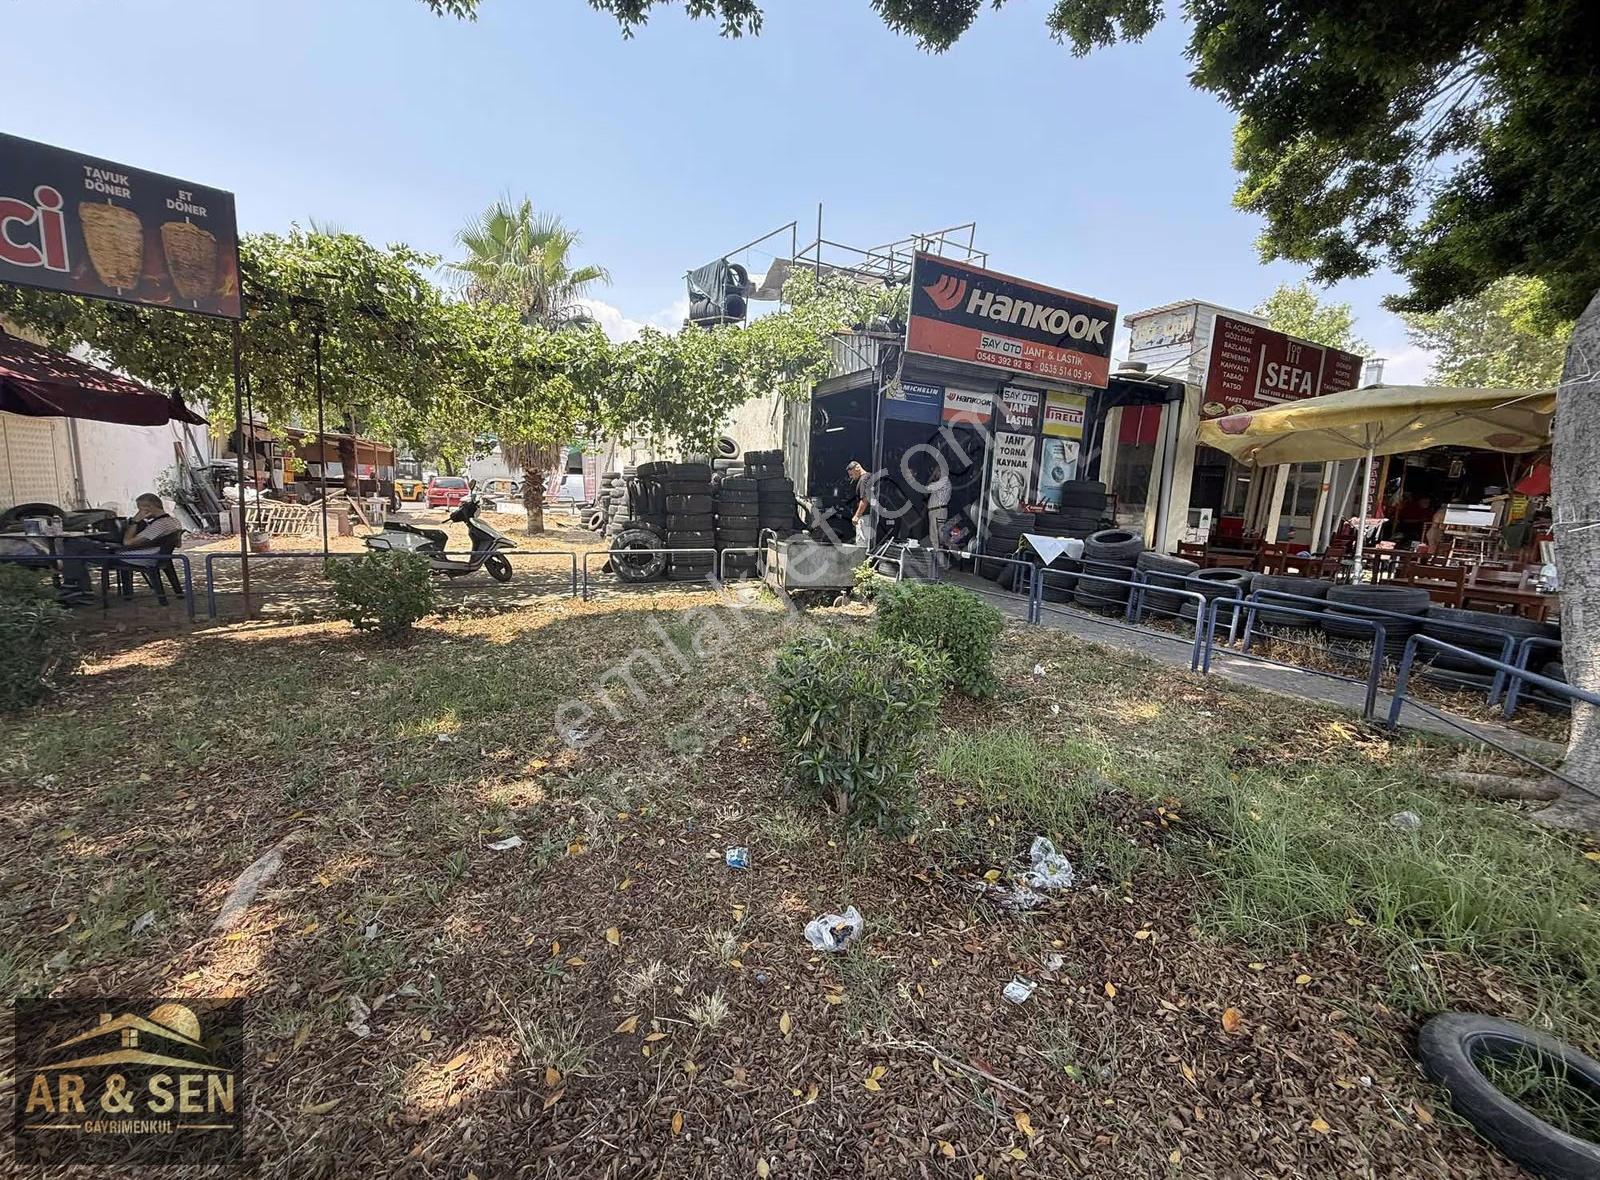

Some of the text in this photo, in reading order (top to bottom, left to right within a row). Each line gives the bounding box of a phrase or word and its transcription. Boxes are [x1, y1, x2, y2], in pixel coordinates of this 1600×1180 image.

[83, 165, 129, 186] TAVUK
[85, 177, 131, 199] DÖNER
[178, 190, 192, 201] ET
[166, 198, 207, 217] DÖNER
[1003, 342, 1022, 354] OTO
[1023, 346, 1046, 358] JANT
[1047, 350, 1054, 359] &
[976, 352, 996, 363] 0545
[1265, 361, 1312, 395] SEFA
[902, 384, 939, 395] MICHELIN
[1222, 381, 1242, 391] PATSO
[1021, 393, 1038, 403] OTO
[1009, 402, 1030, 414] JANT
[1006, 413, 1033, 427] LASTİK
[1045, 405, 1084, 424] PIRELLI
[1005, 435, 1026, 446] JANT
[1000, 446, 1026, 457] TORNA
[996, 458, 1028, 468] KAYNAK
